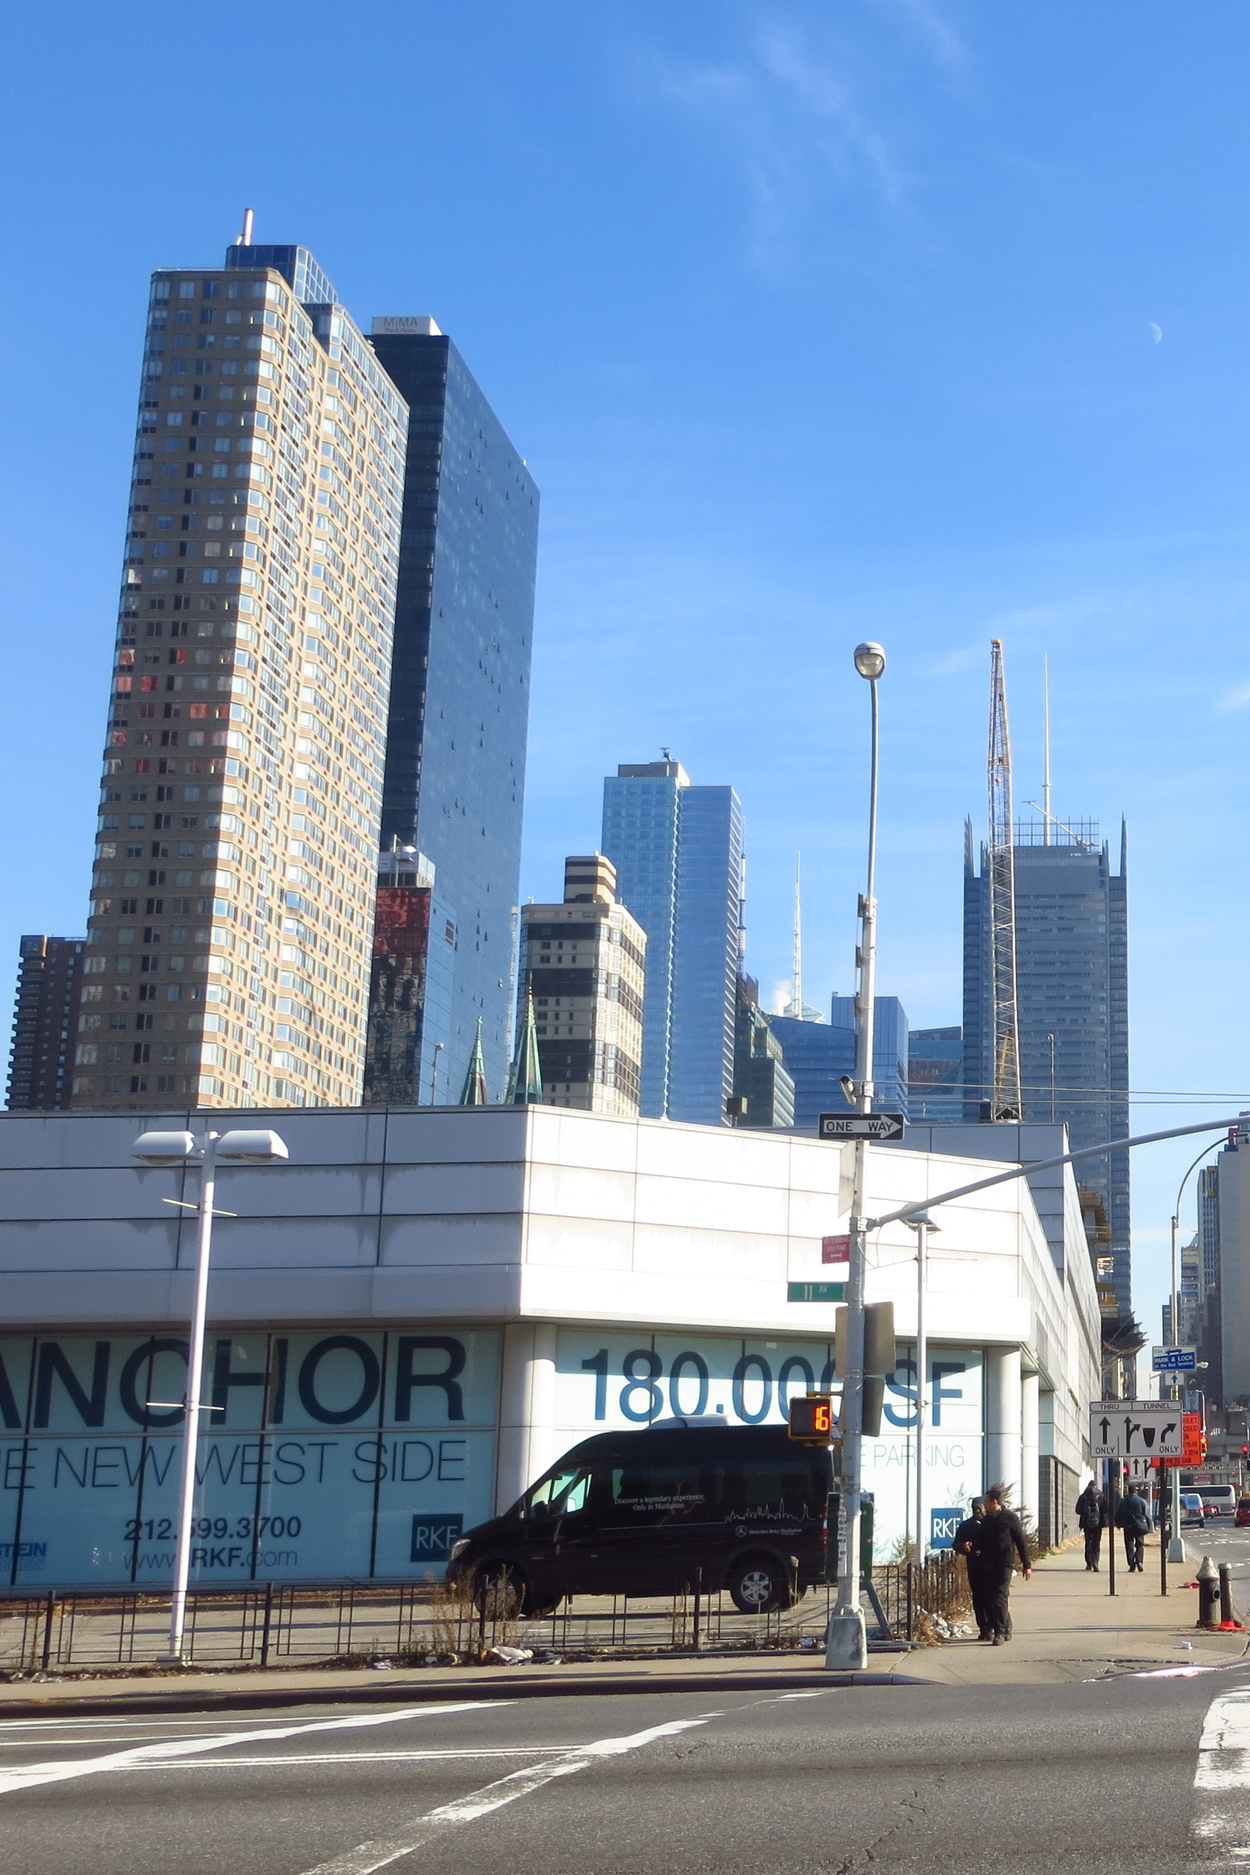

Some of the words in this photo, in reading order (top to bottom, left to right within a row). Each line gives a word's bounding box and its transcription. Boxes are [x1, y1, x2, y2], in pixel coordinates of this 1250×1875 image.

[826, 1121, 853, 1132] ONE
[868, 1121, 894, 1132] WAY
[804, 1285, 813, 1300] 11
[819, 1285, 829, 1294] AV
[884, 1359, 966, 1428] SF
[1100, 1402, 1120, 1410] THRU
[815, 1406, 829, 1431] 16
[1095, 1446, 1115, 1455] ONLY
[1159, 1445, 1179, 1453] ONLY
[54, 1446, 176, 1489] NEW
[195, 1442, 339, 1486] WEST
[352, 1439, 467, 1484] SIDE
[416, 1525, 459, 1549] RKF
[933, 1518, 962, 1539] RKF
[123, 1547, 298, 1570] wwwRKF.com
